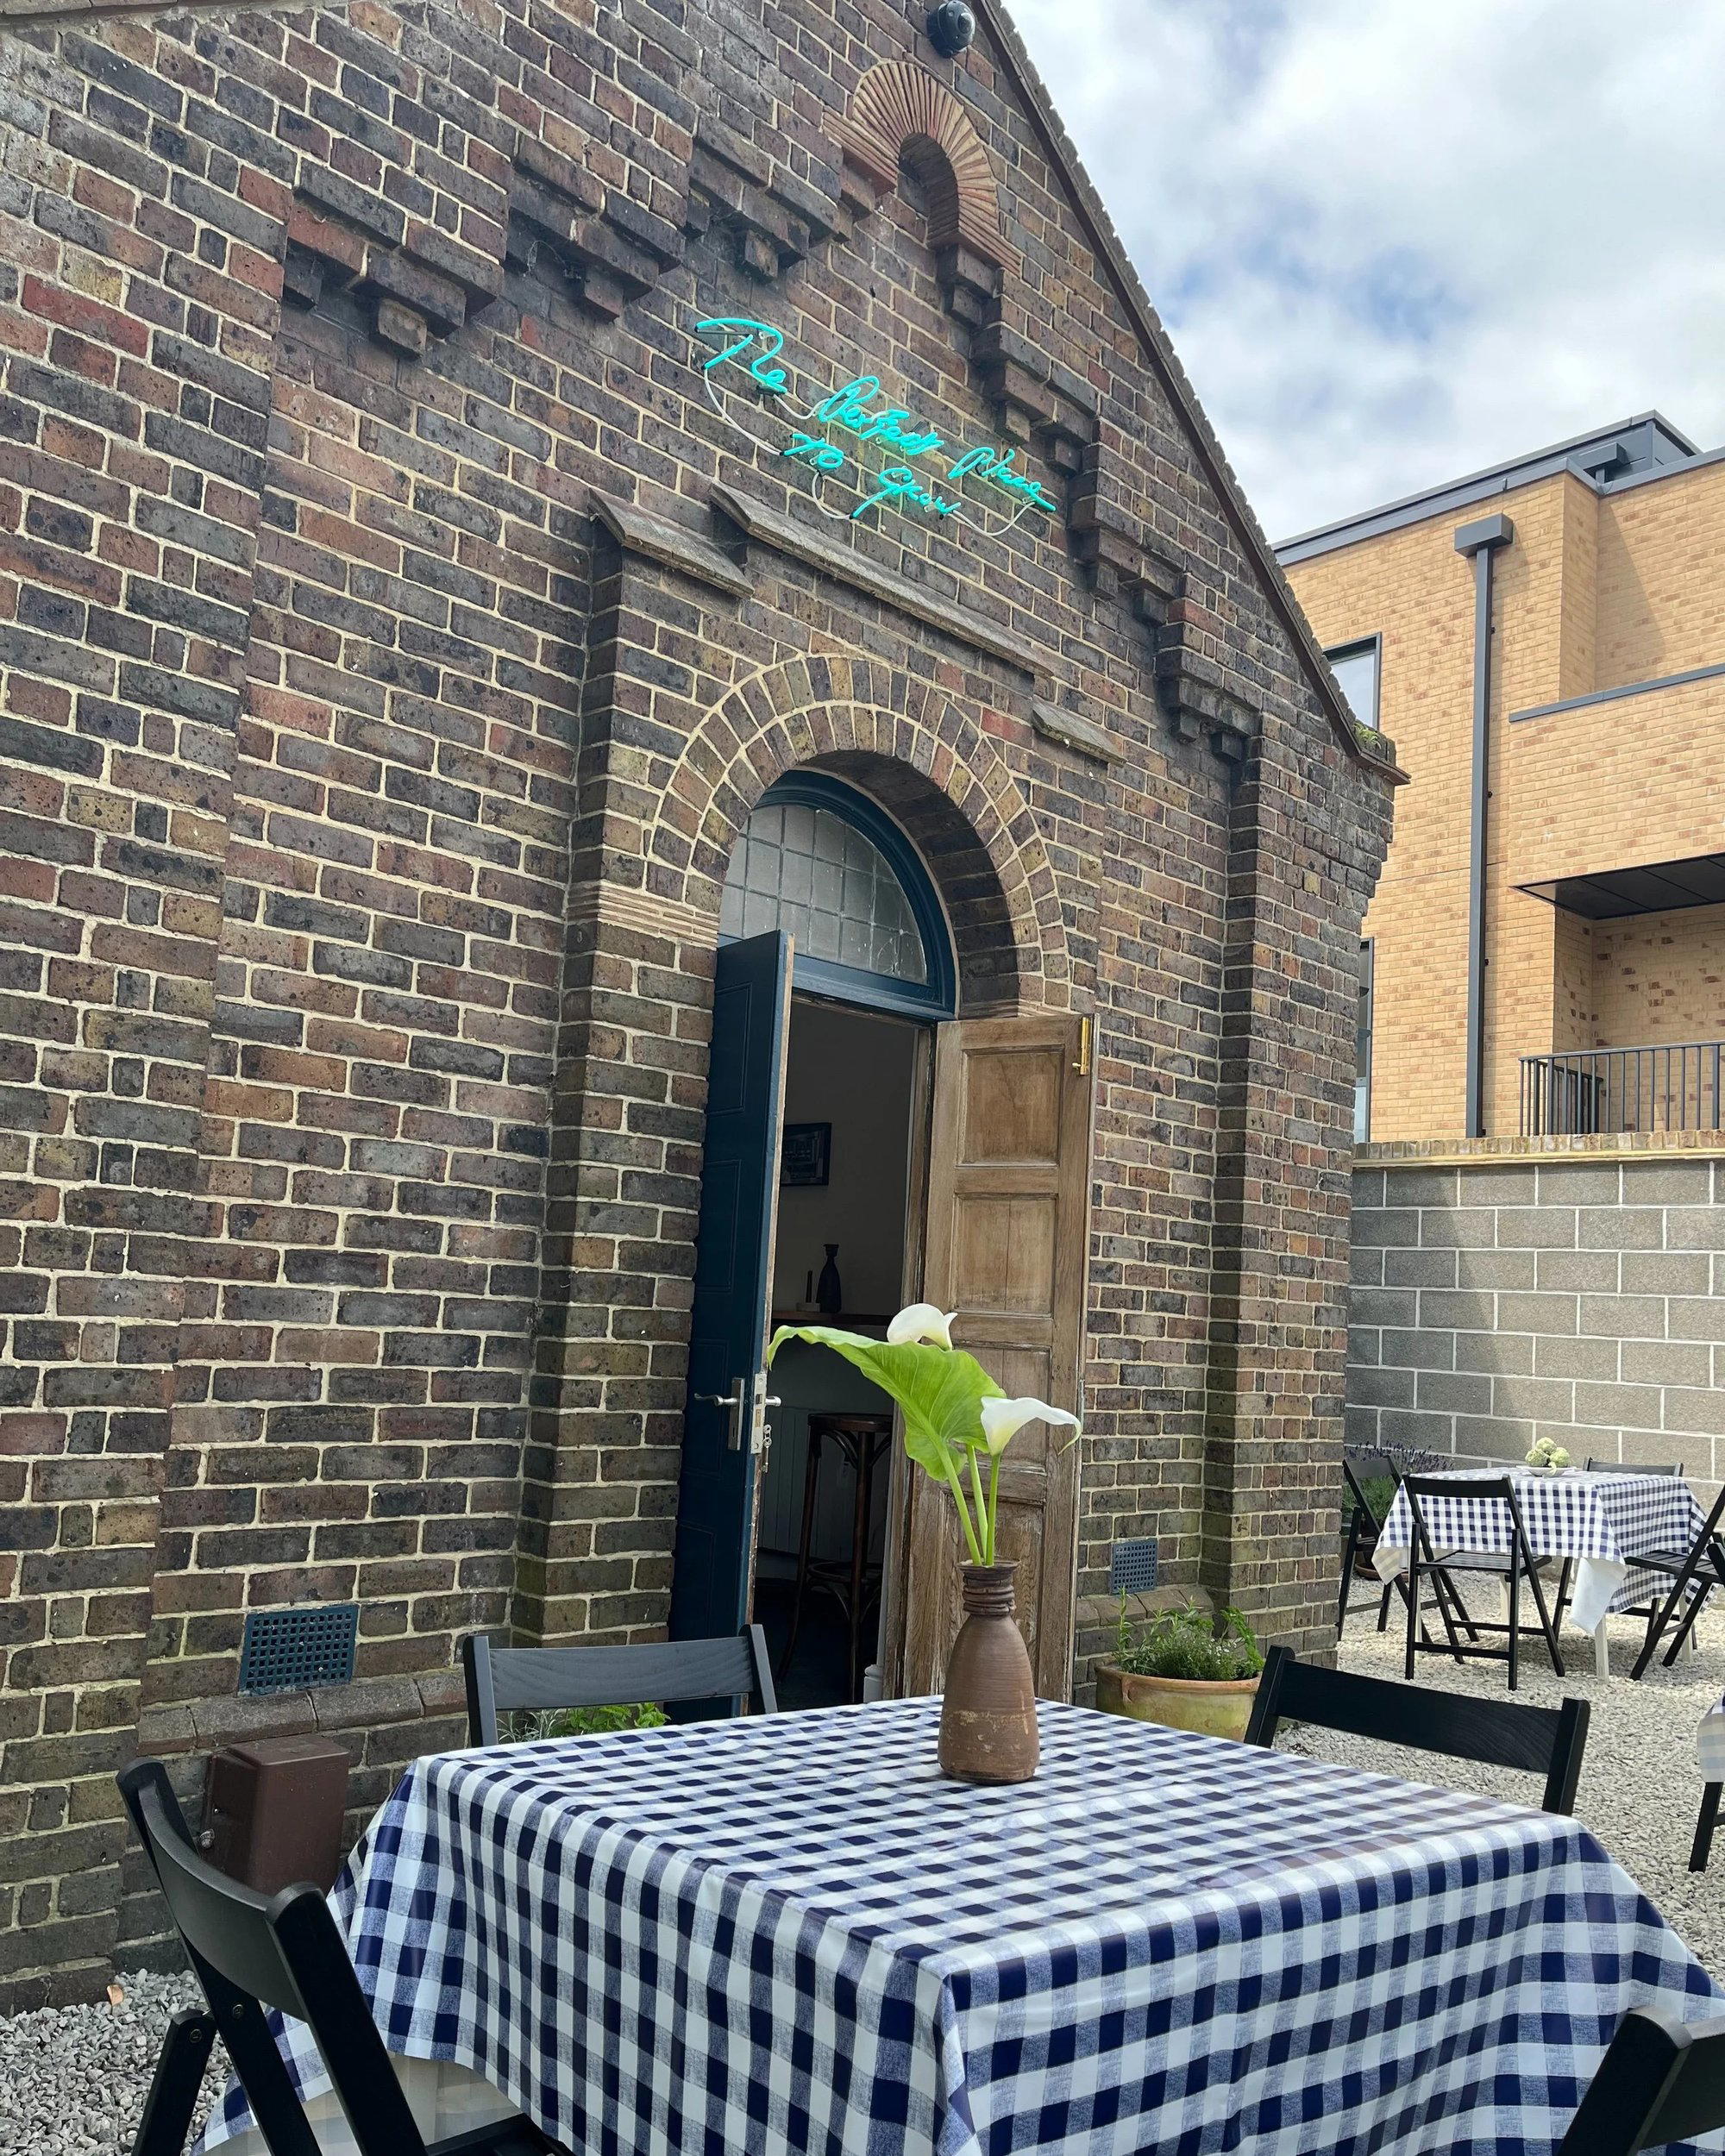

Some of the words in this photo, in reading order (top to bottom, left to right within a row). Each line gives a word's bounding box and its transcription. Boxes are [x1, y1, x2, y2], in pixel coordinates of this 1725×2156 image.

[695, 318, 787, 393] The
[818, 375, 944, 455] Perfect
[947, 447, 1057, 511] Place
